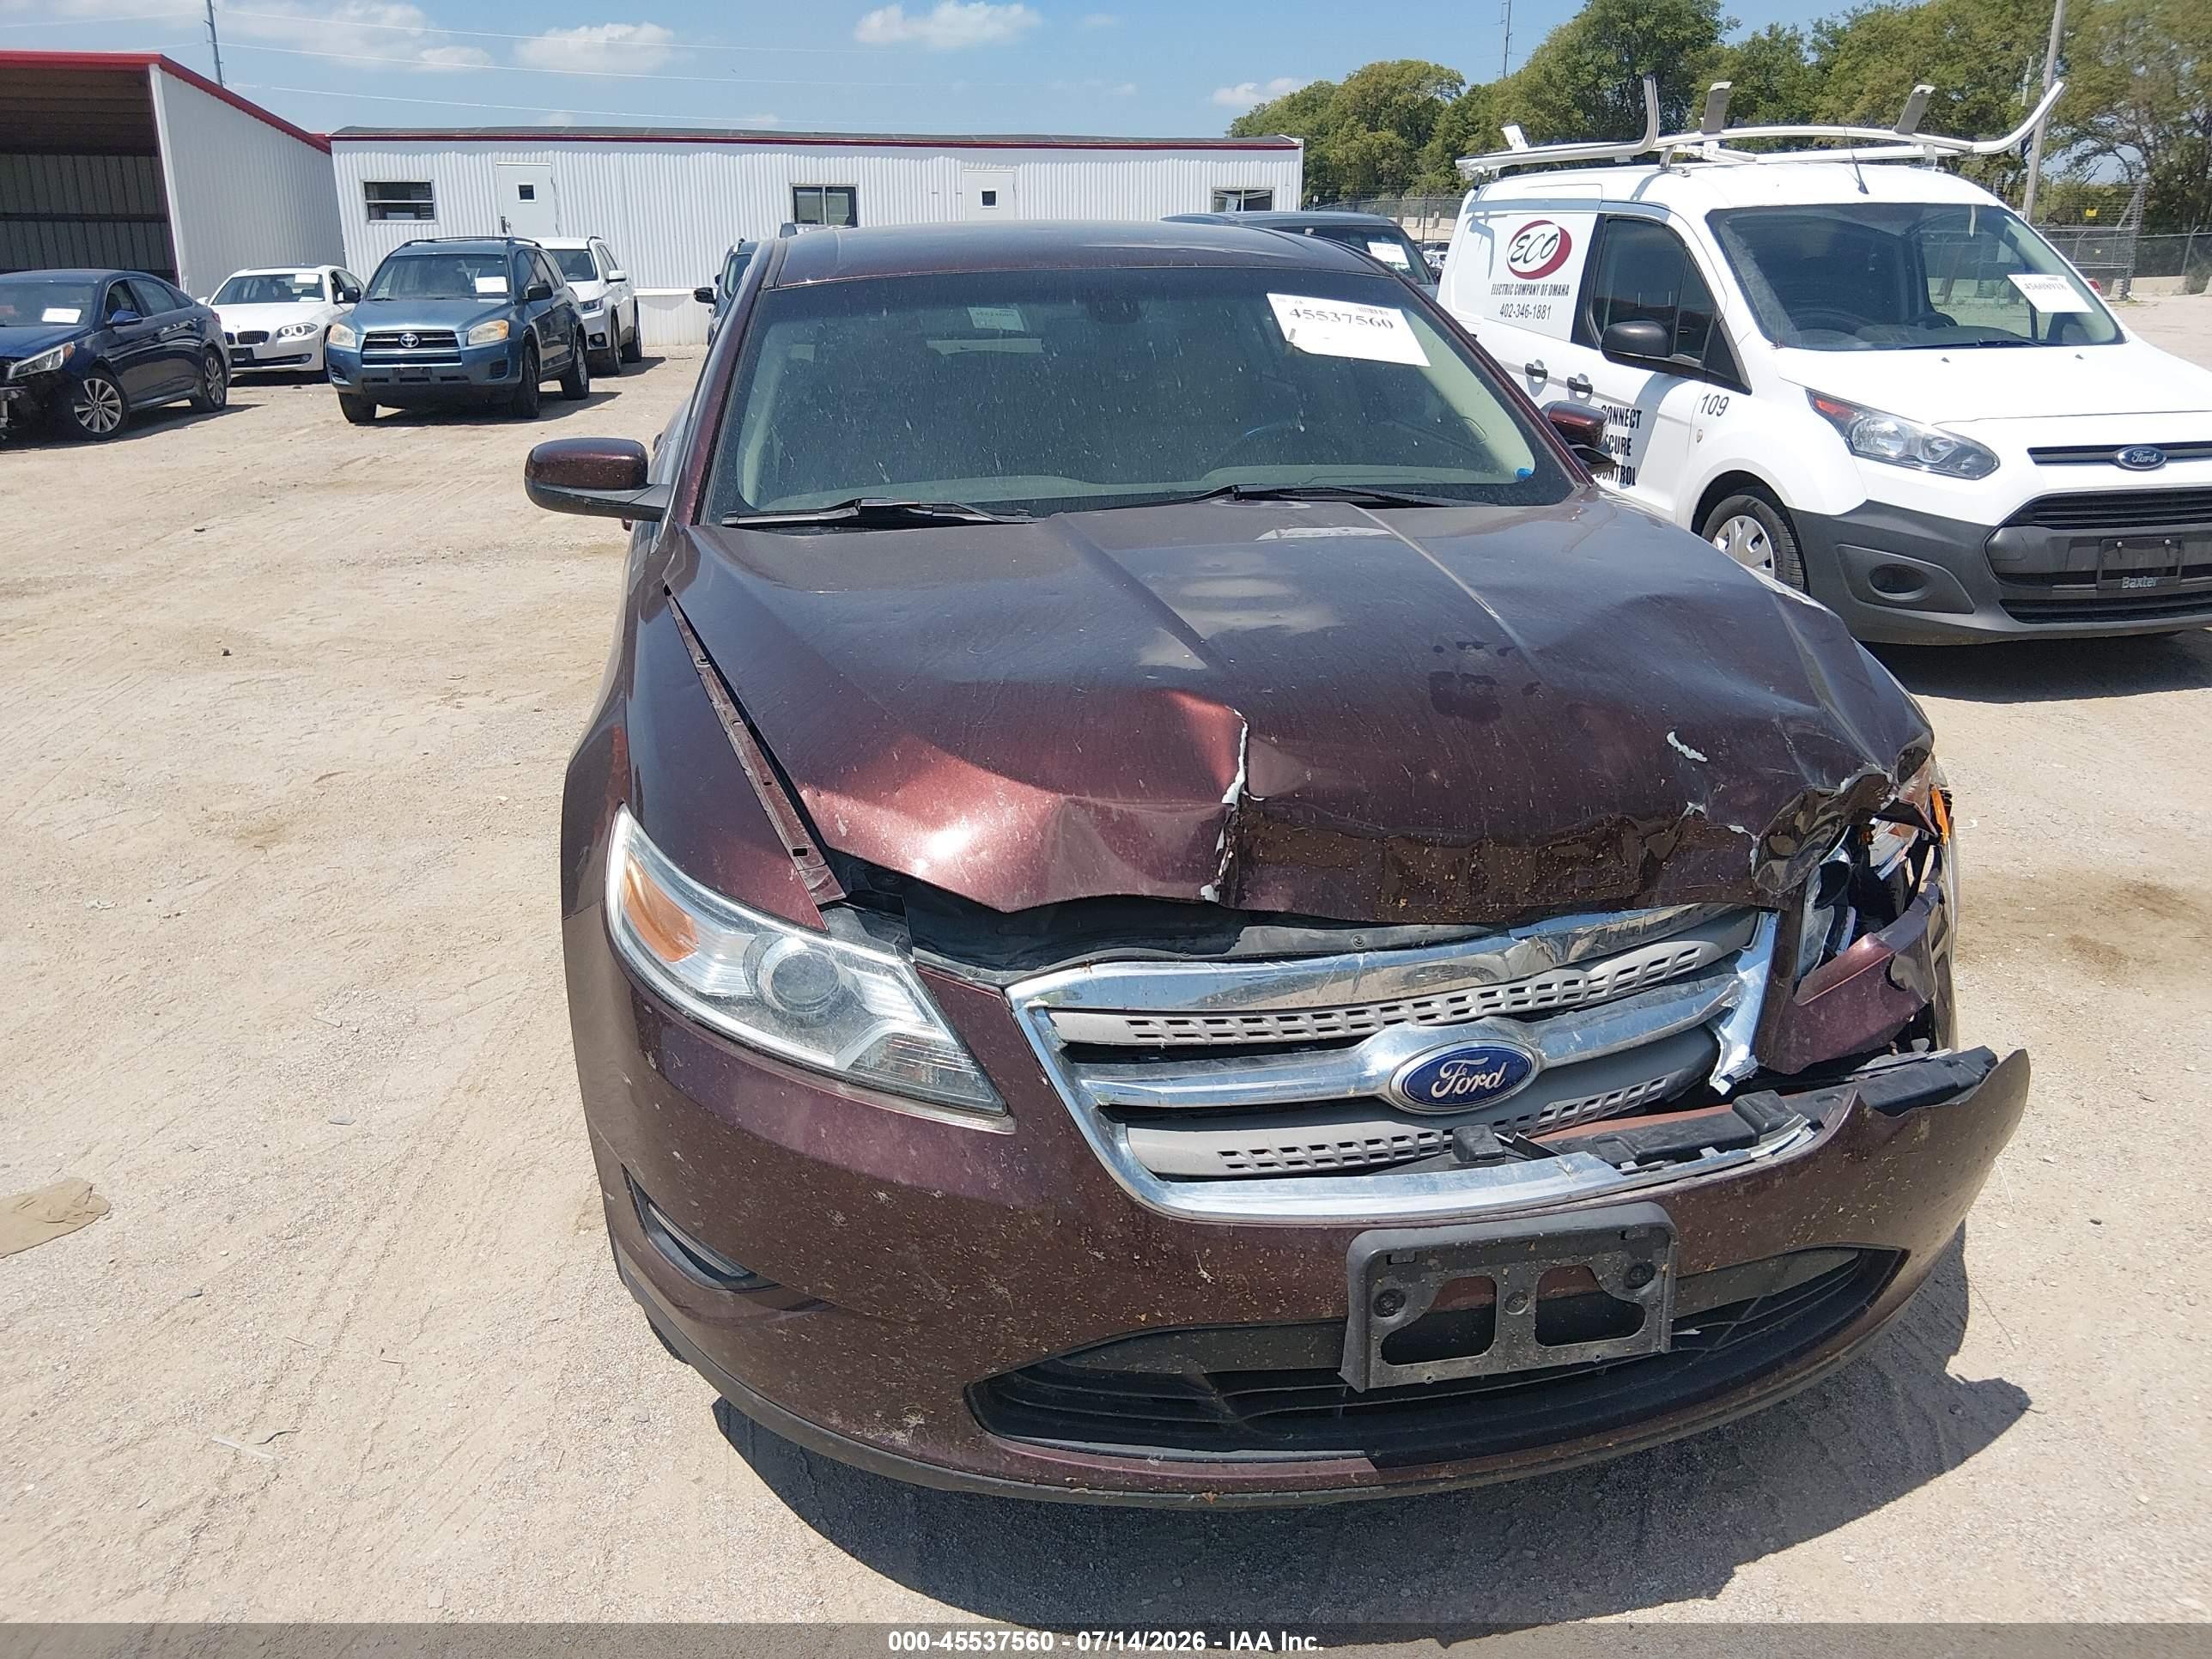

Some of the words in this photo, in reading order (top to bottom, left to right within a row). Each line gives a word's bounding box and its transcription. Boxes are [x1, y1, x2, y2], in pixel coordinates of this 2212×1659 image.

[1510, 233, 1559, 264] ECO
[1491, 283, 1514, 296] ELECTRIC
[1514, 283, 1540, 296] COMPANY
[1540, 284, 1549, 296] OF
[1548, 284, 1570, 296] OMAHA
[1290, 308, 1394, 330] 45537560
[1499, 303, 1552, 319] 402-346-1881
[1700, 393, 1729, 416] 109
[1606, 434, 1632, 456] CURE
[2131, 450, 2158, 463] Ford
[2122, 576, 2159, 588] Baxter
[1431, 1056, 1508, 1098] Ford
